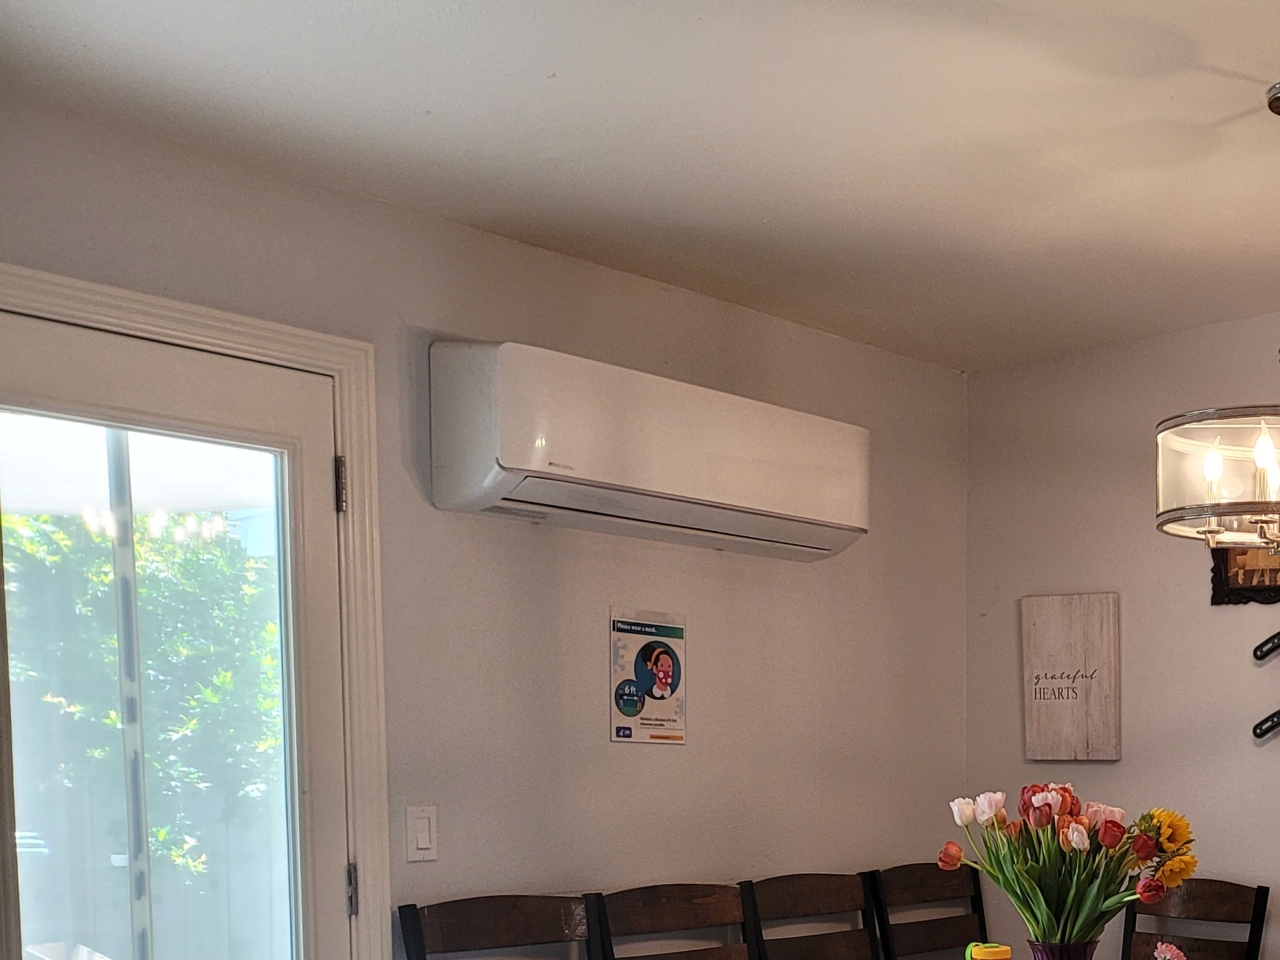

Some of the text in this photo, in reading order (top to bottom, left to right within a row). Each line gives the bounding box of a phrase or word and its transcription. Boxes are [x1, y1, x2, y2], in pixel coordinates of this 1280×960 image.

[1034, 669, 1098, 686] grateful
[624, 685, 637, 695] 6 ft
[1034, 687, 1078, 700] HEARTS
